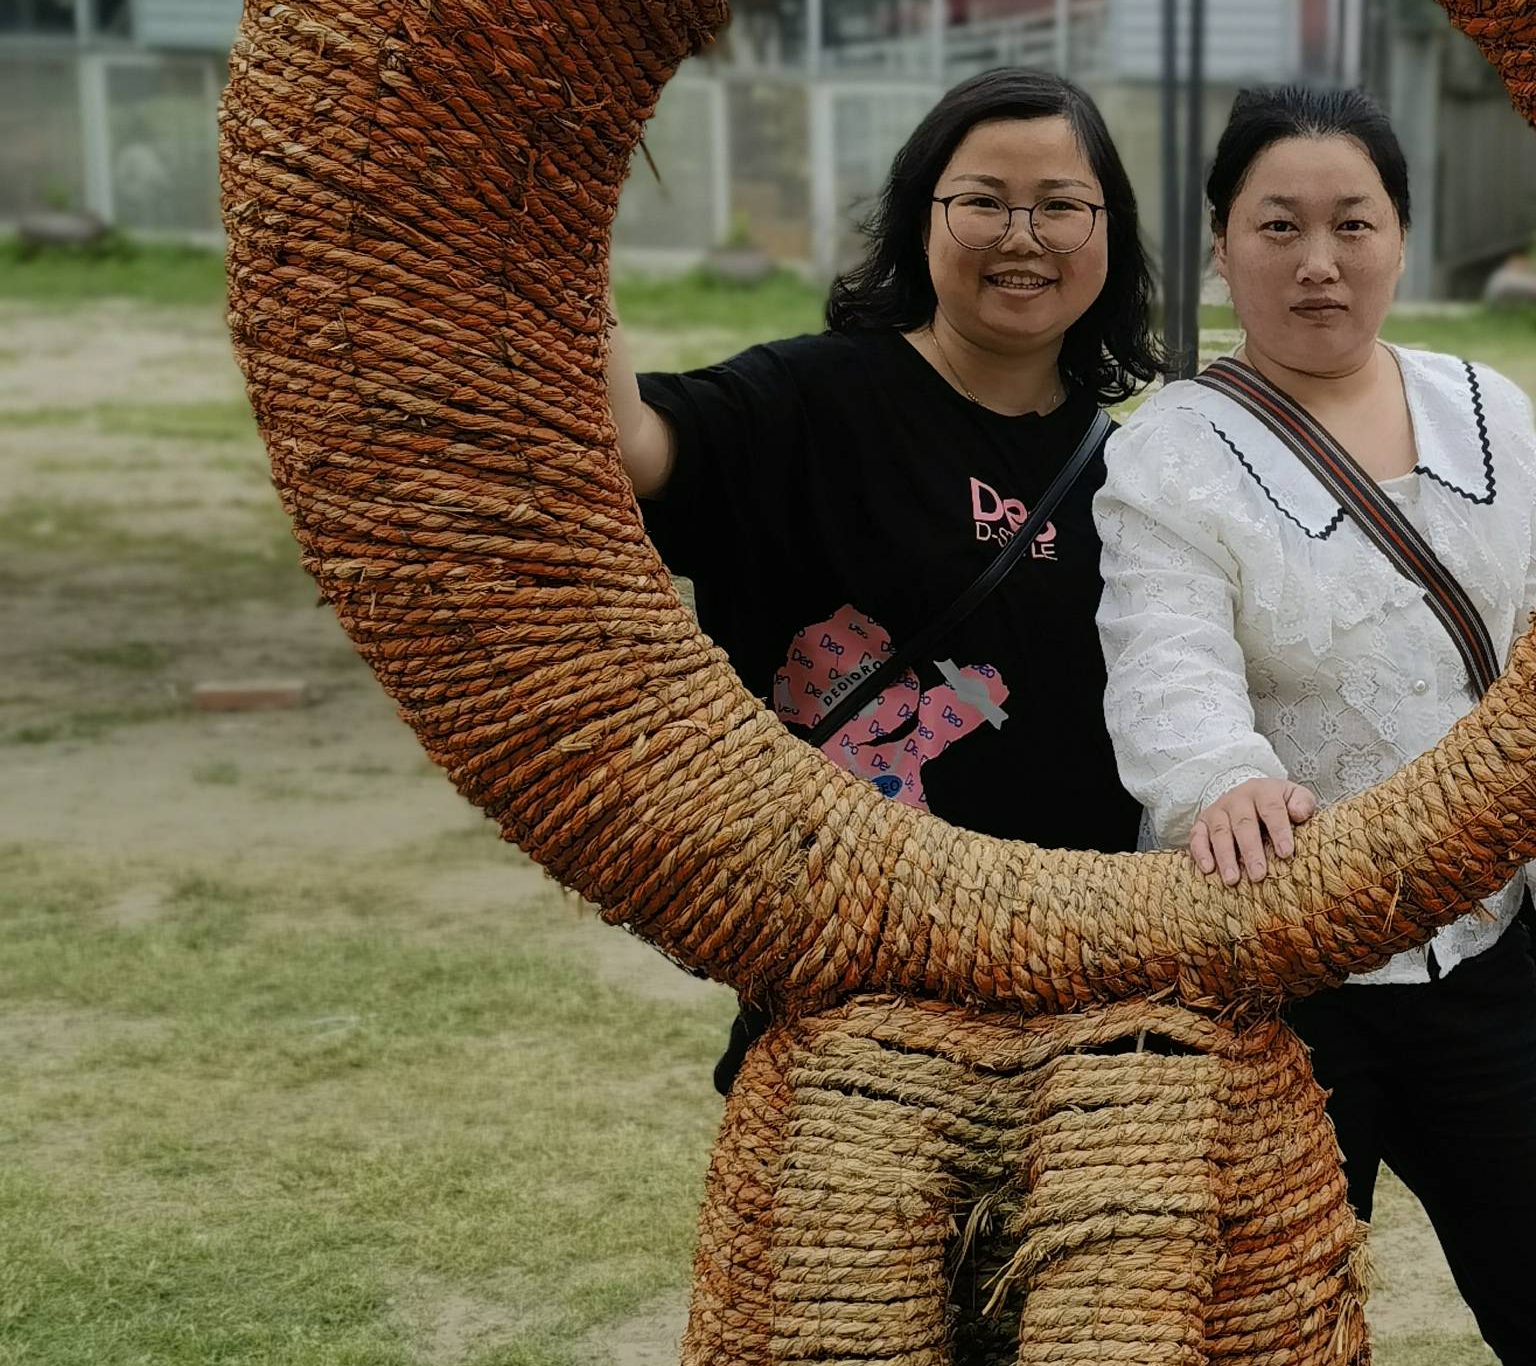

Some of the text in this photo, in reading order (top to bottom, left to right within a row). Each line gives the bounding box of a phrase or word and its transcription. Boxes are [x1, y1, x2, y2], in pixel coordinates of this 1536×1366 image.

[819, 633, 845, 656] Deo
[791, 647, 815, 670] Deo
[804, 681, 824, 699] De
[942, 705, 964, 728] Deo
